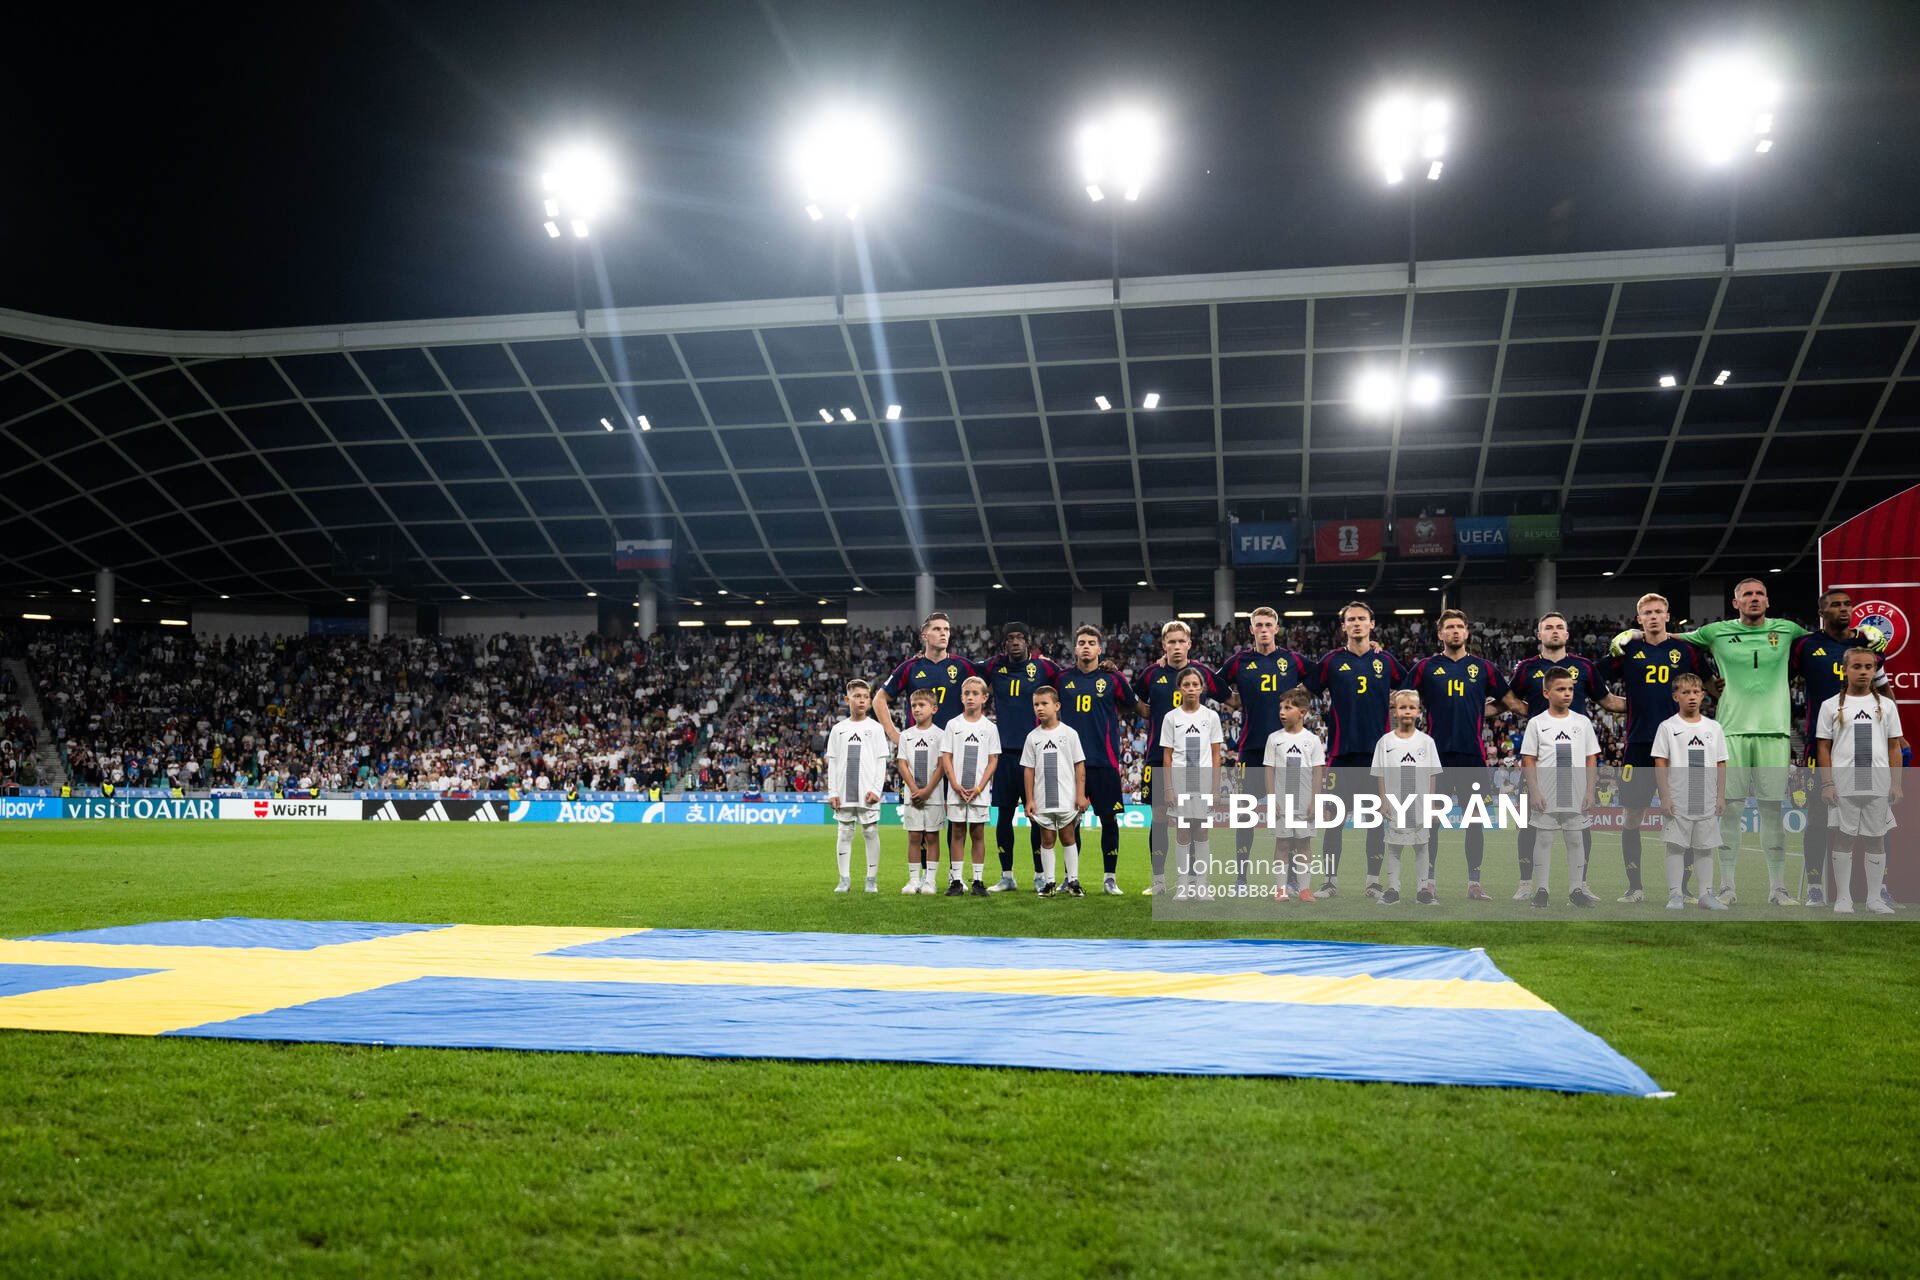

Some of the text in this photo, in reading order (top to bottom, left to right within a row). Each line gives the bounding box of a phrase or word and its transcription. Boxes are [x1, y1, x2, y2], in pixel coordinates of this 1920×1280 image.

[1241, 535, 1287, 551] FIFA
[1459, 529, 1504, 544] UEFA
[1855, 604, 1895, 618] UEFA
[1261, 674, 1277, 692] 21
[1646, 665, 1669, 684] 20
[1010, 679, 1020, 697] 11
[1357, 675, 1367, 694] 3
[1448, 679, 1464, 697] 14
[1076, 694, 1092, 712] 18
[1172, 690, 1183, 708] 8
[1143, 766, 1152, 783] 8
[556, 802, 615, 823] Atos
